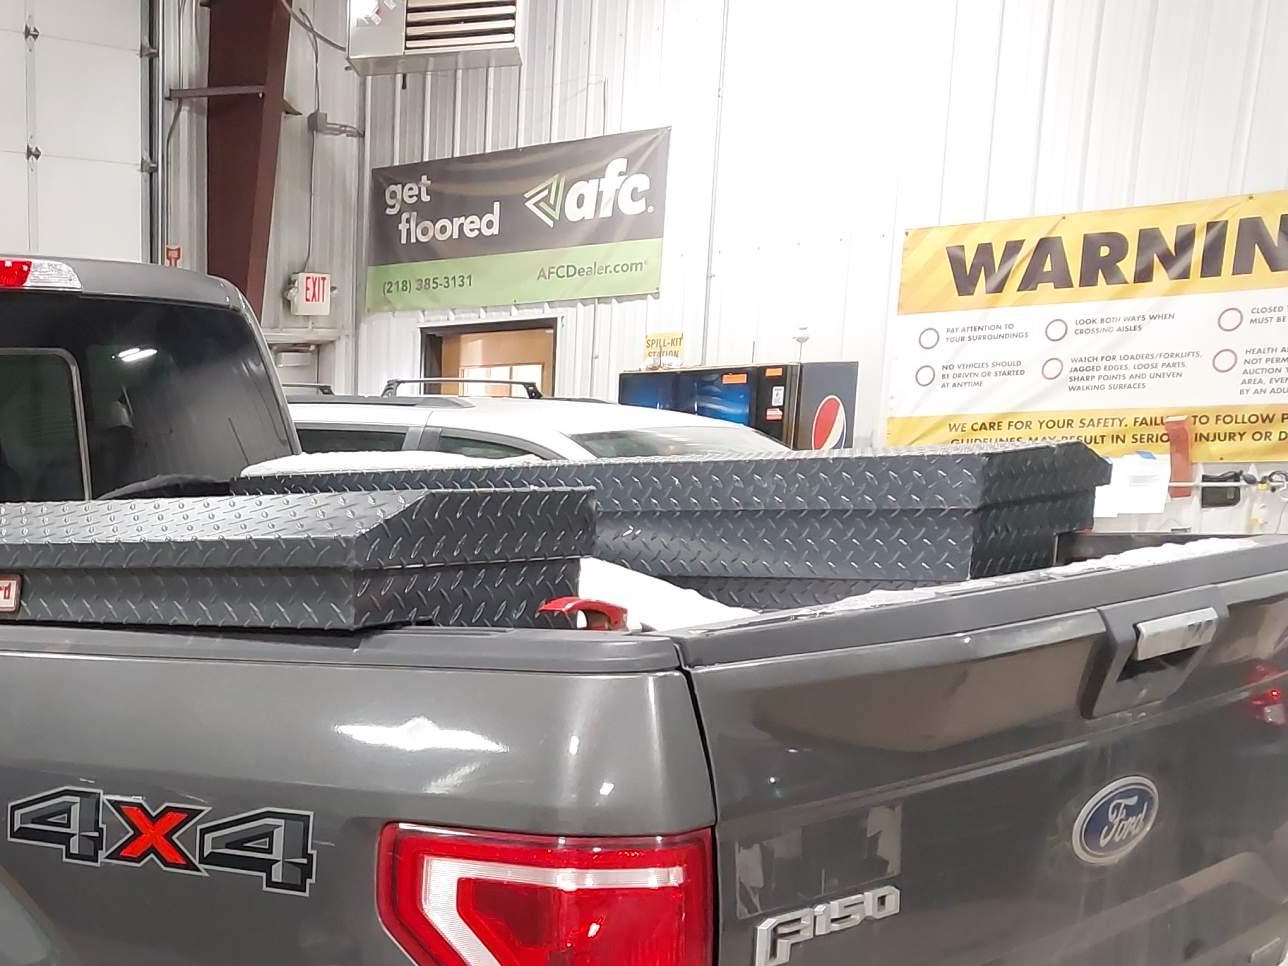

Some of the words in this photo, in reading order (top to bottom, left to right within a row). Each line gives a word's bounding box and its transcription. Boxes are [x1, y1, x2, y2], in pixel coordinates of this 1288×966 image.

[385, 175, 431, 215] get
[399, 201, 500, 244] floored
[537, 261, 644, 282] AFCDealer.com
[306, 276, 327, 303] EXIT
[383, 279, 411, 295] (218)
[416, 274, 472, 290] 385-3131
[1250, 305, 1284, 314] CLOSED
[1148, 313, 1175, 321] WHEN
[1249, 316, 1274, 325] MUST
[1116, 324, 1143, 332] AISLES
[967, 332, 1029, 342] SURROUNDINGS
[1245, 347, 1278, 355] HEALTH
[991, 360, 1022, 368] SHOULD
[1243, 357, 1262, 365] NOT
[994, 369, 1026, 377] STARTED
[1069, 365, 1101, 373] JAGGED
[1242, 367, 1282, 375] AUCTION
[1098, 373, 1127, 381] POINTS
[1149, 371, 1183, 379] UNEVEN
[1068, 384, 1106, 392] WALKING
[1108, 382, 1146, 390] SURFACES
[948, 423, 967, 433] WE
[970, 420, 1003, 431] CARE
[1007, 420, 1032, 430] FOR
[1037, 418, 1074, 429] YOUR
[1078, 416, 1128, 429] SAFETY.
[1192, 415, 1210, 425] TO
[1215, 413, 1276, 425] FOLLOW
[1112, 435, 1126, 444] IN
[1194, 431, 1246, 442] INJURY
[1251, 431, 1272, 441] OR
[1099, 797, 1150, 848] Ford
